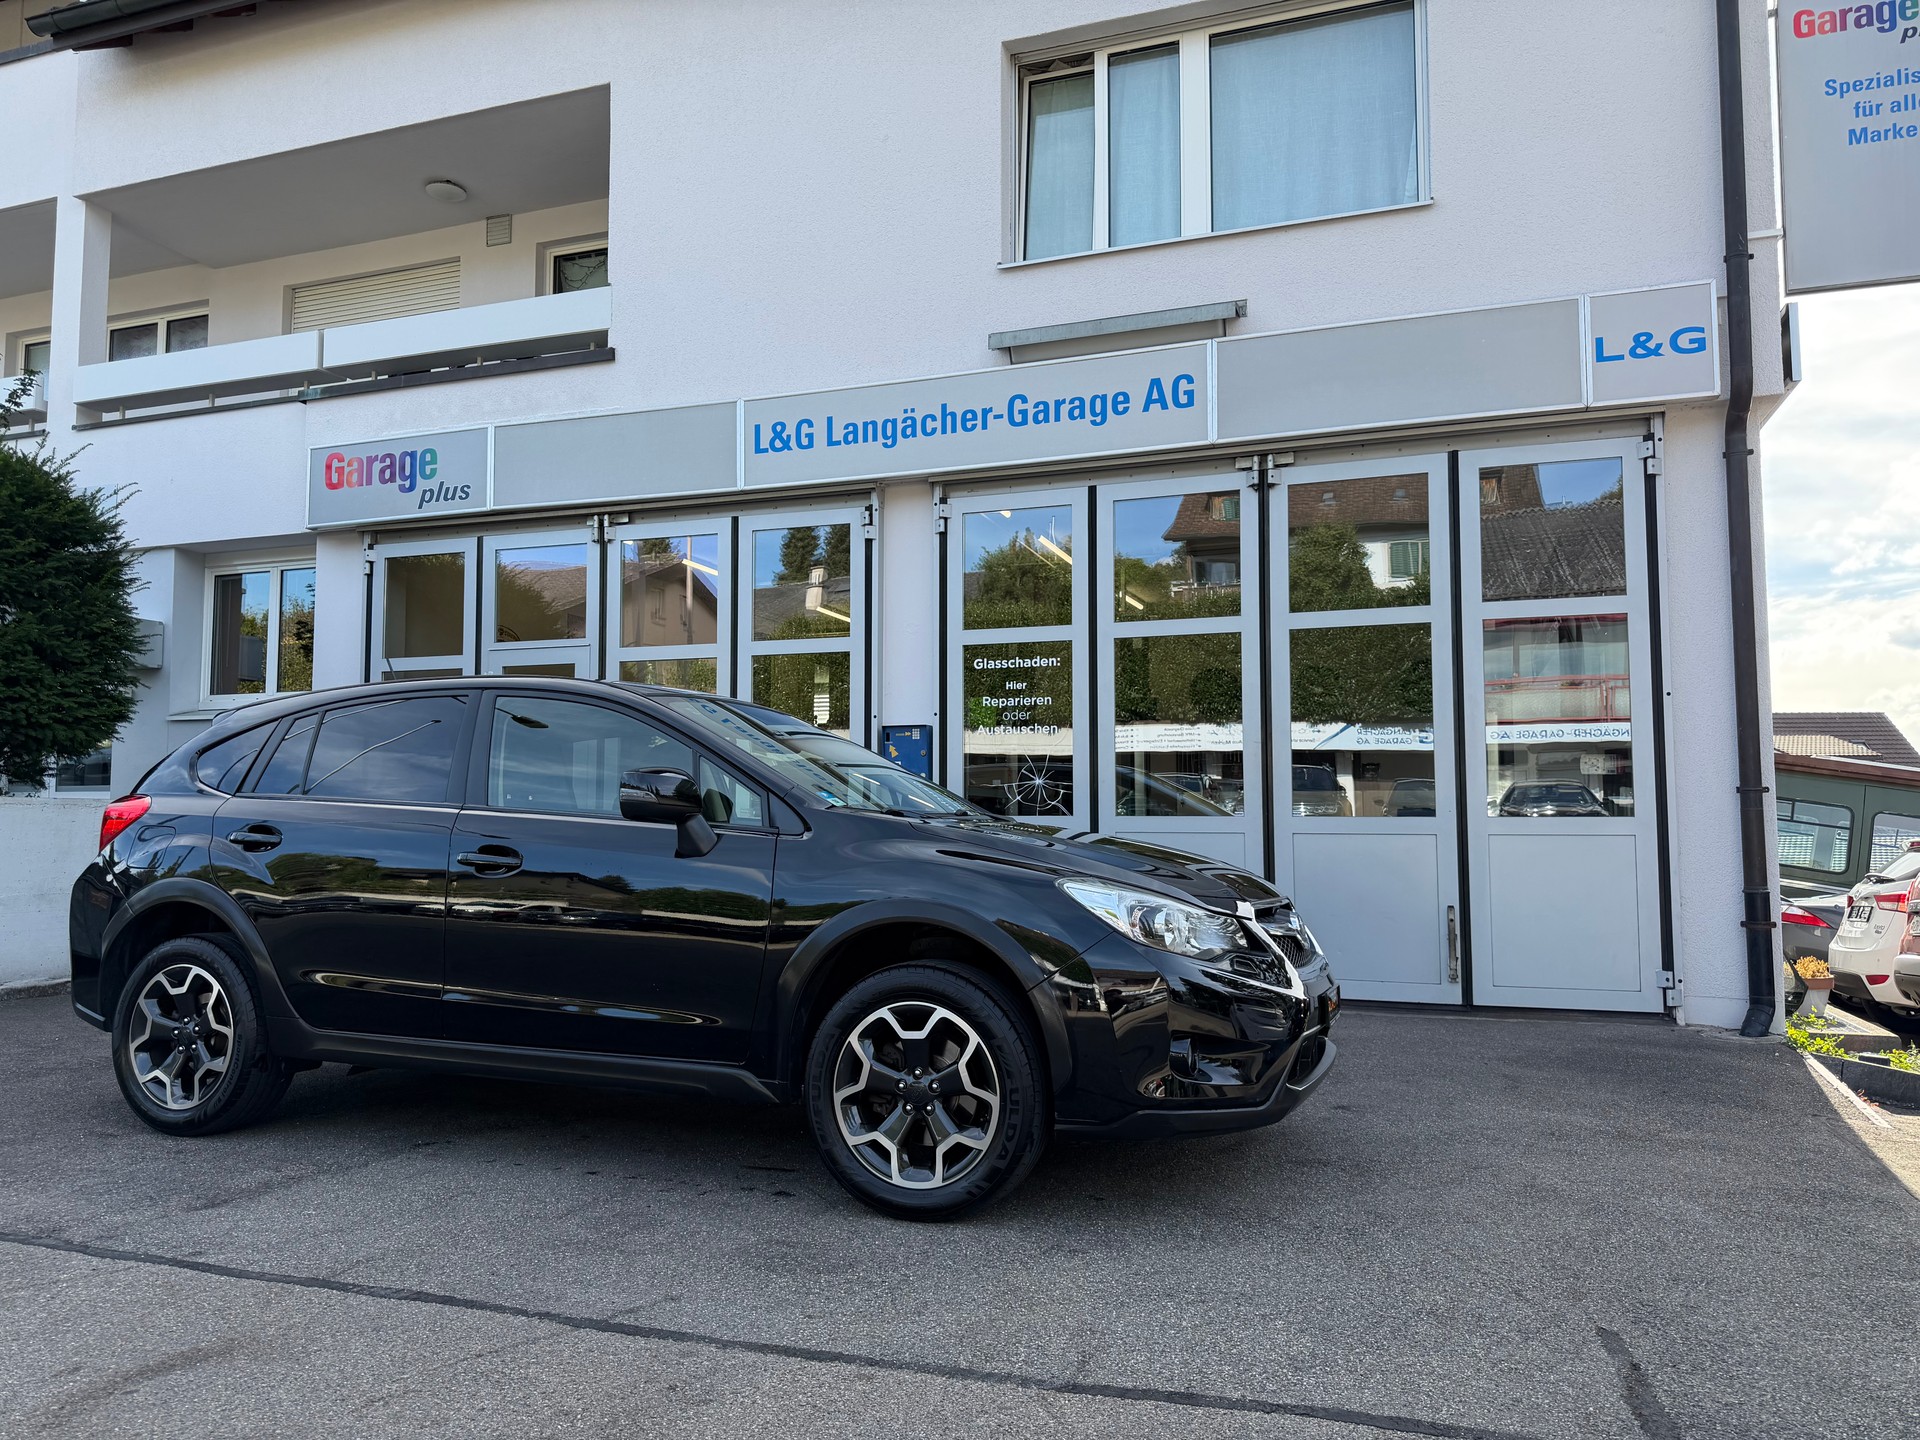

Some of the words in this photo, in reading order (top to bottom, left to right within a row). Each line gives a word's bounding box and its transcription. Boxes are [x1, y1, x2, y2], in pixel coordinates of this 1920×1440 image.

[1793, 0, 1919, 39] Garage
[1900, 25, 1920, 44] p
[1853, 101, 1883, 118] für
[1890, 94, 1920, 114] all
[1595, 326, 1707, 363] L&G
[754, 417, 815, 454] L&G
[826, 390, 1131, 450] Langächer-Garage
[1141, 373, 1195, 413] AG
[324, 446, 438, 493] Garage
[417, 481, 472, 510] plus
[973, 656, 1061, 670] Glasschaden:
[1005, 680, 1027, 690] Hier
[982, 694, 1052, 708] Reparieren
[1002, 709, 1031, 721] oder
[977, 723, 1058, 736] Austauschen
